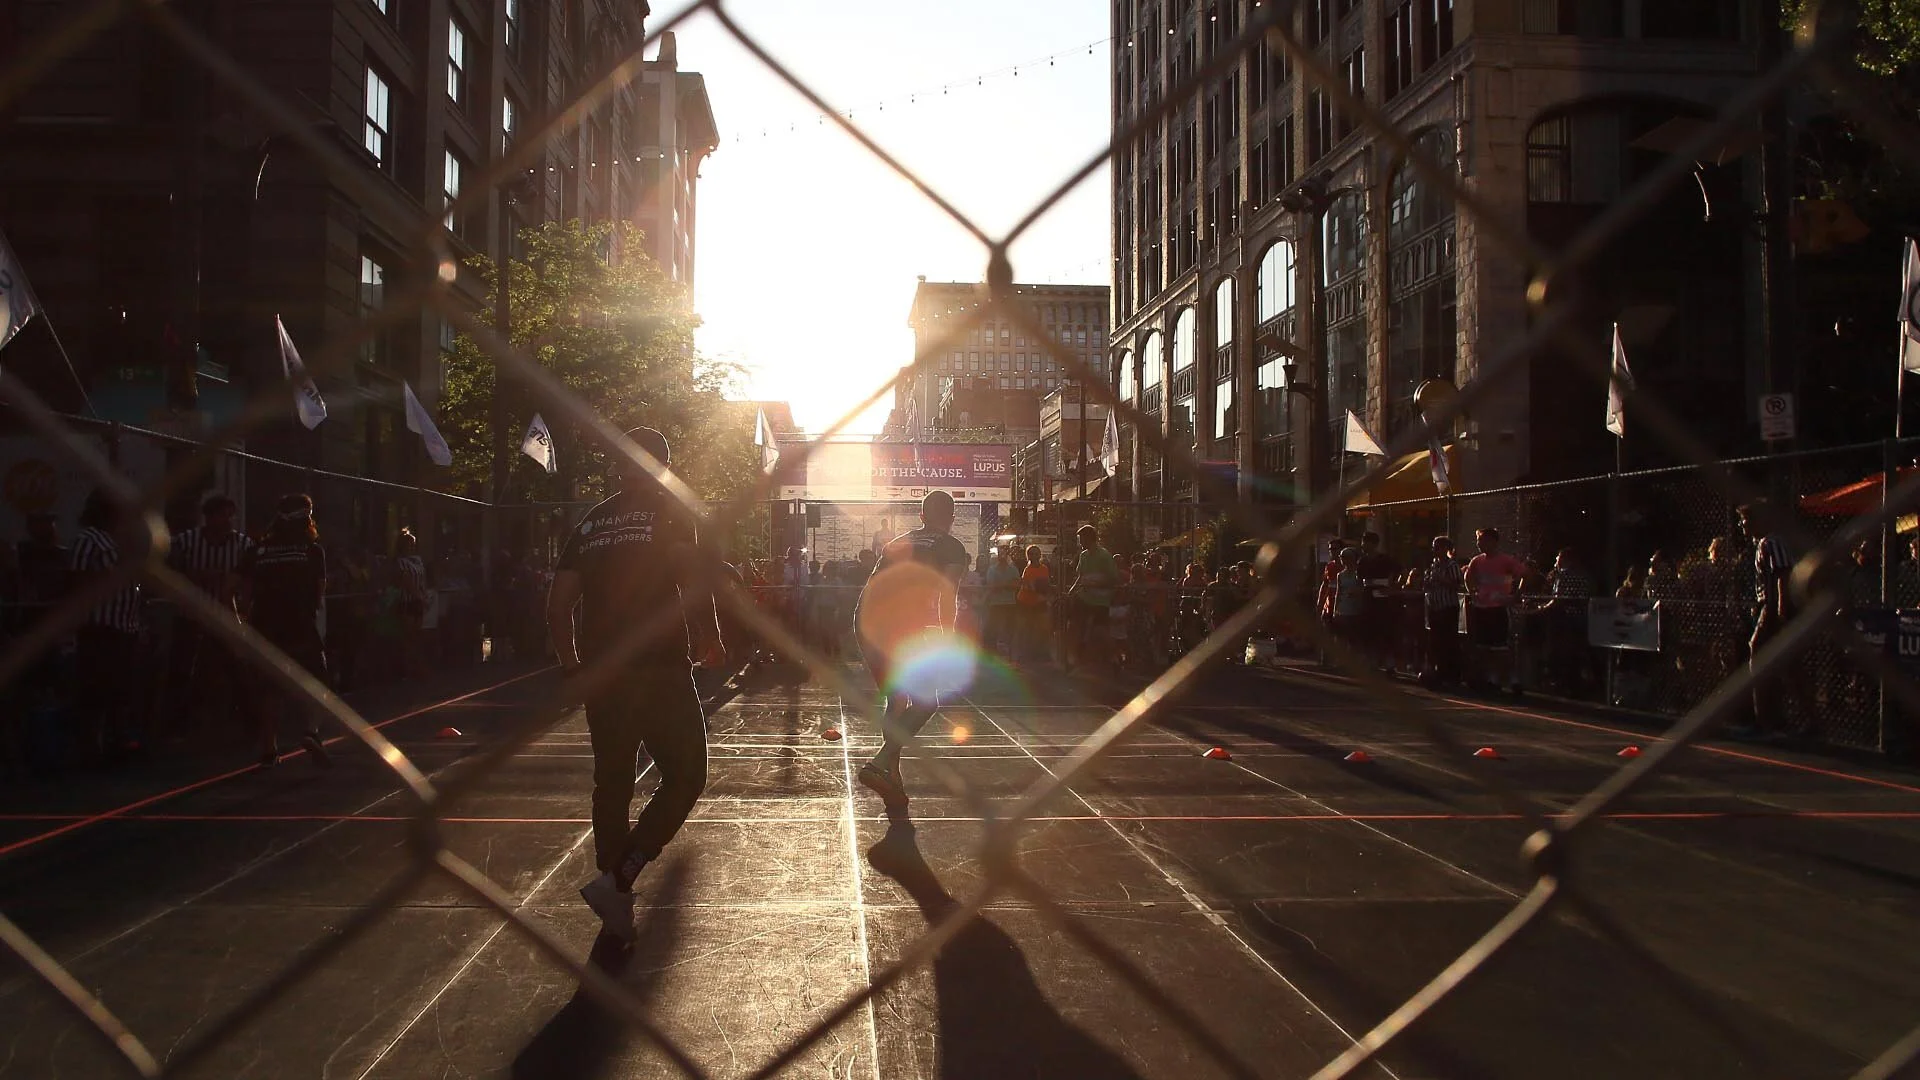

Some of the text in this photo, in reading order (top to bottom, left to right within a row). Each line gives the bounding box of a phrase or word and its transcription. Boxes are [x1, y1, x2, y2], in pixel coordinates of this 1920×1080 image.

[890, 467, 917, 478] THE
[920, 467, 967, 479] CAUSE.
[973, 462, 1006, 472] LUPUS
[594, 511, 657, 528] MANIFEST
